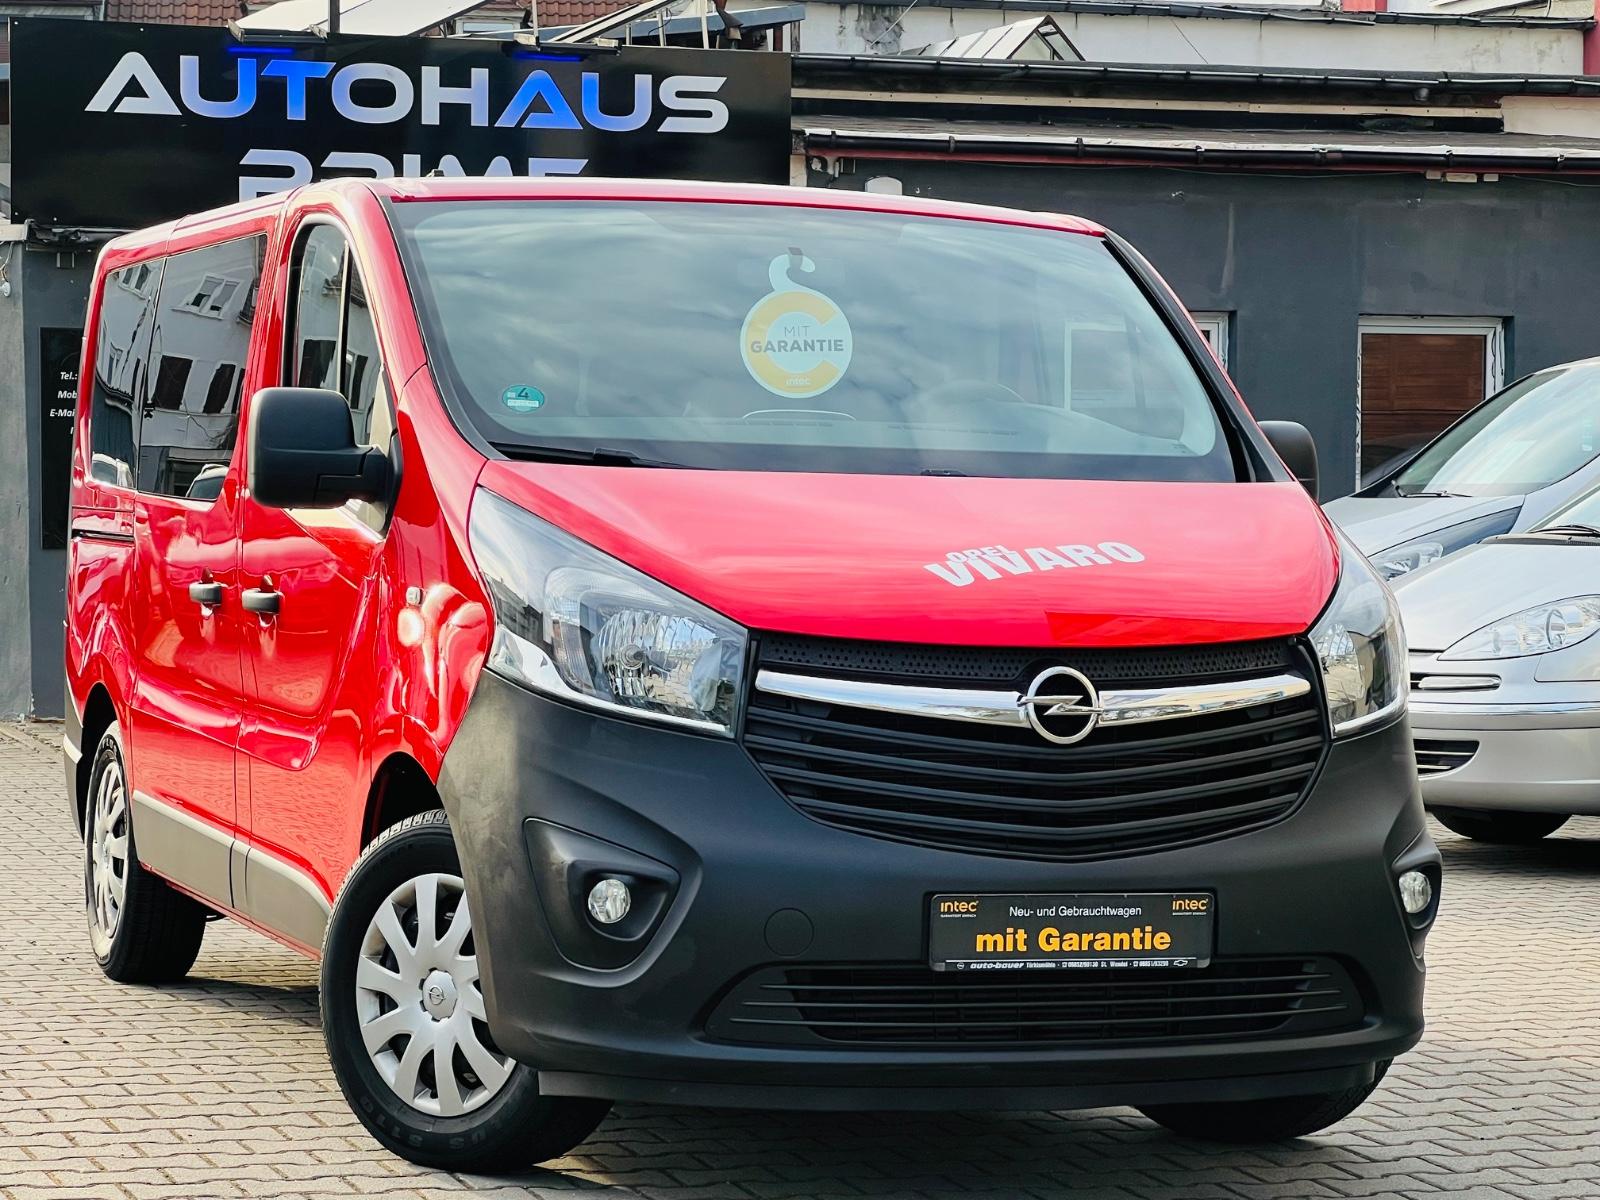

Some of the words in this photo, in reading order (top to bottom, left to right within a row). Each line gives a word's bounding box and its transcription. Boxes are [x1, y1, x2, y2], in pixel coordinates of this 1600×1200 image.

[85, 51, 729, 134] AUTOHAUS
[784, 325, 810, 337] MIT
[750, 339, 844, 353] GARANTIE
[60, 371, 78, 380] Tel.:
[517, 387, 530, 399] 4
[945, 545, 1016, 563] OPEL
[923, 541, 1146, 587] VIVARO
[940, 900, 977, 913] intec
[1009, 905, 1034, 917] Neu-
[1036, 906, 1056, 917] und
[1058, 905, 1142, 918] Gebrauchtwagen
[1172, 899, 1208, 911] intec
[976, 928, 1027, 952] mit
[1038, 925, 1171, 952] Garantie
